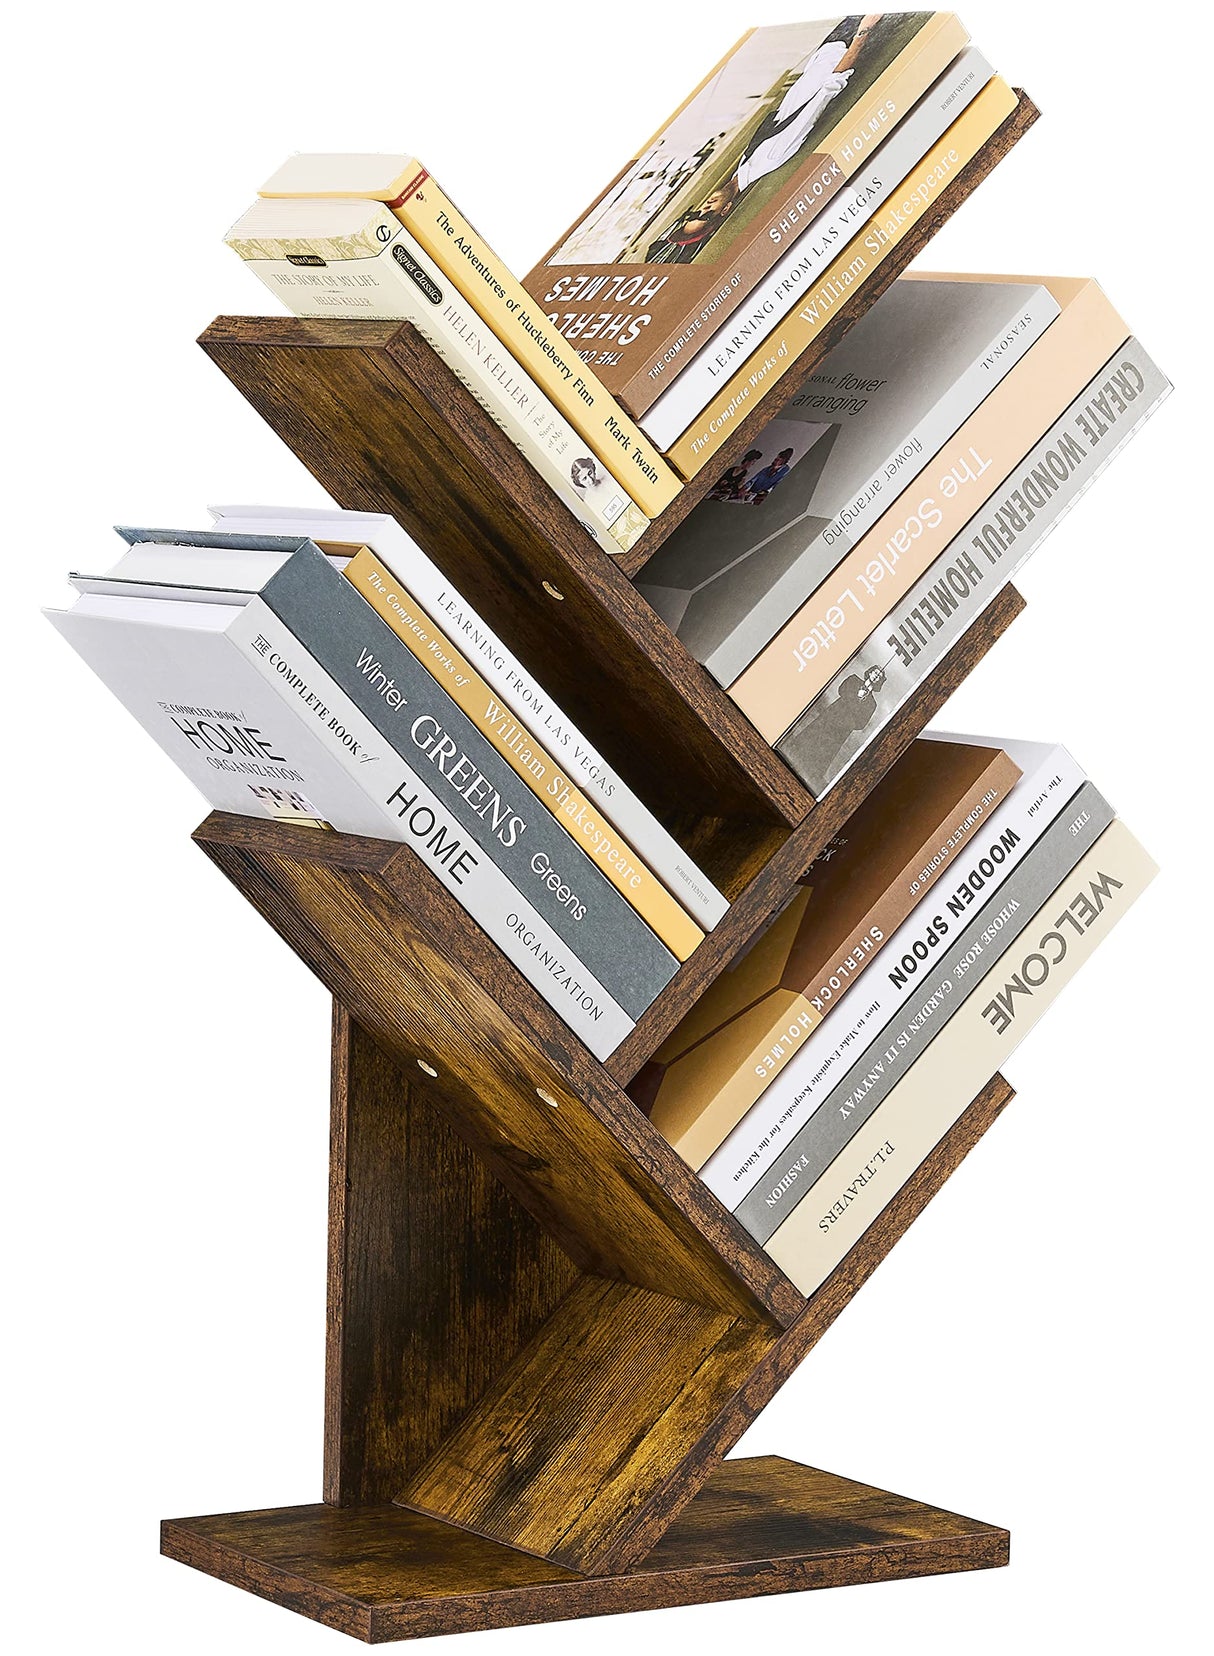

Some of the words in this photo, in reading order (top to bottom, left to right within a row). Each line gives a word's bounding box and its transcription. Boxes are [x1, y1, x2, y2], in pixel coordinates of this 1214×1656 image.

[648, 360, 666, 380] THE
[663, 317, 702, 363] COMPLETE
[700, 286, 732, 323] STORIES
[730, 272, 743, 293] OF
[769, 162, 842, 244] SHERLOCK
[841, 99, 896, 162] HOLMES
[272, 274, 293, 285] THE
[322, 275, 336, 287] OF
[356, 275, 380, 287] LIFE
[393, 247, 417, 273] Signet
[414, 269, 442, 304] Classics
[544, 276, 669, 306] HOLMES
[707, 300, 775, 377] LEARNING
[774, 256, 812, 301] FROM
[811, 226, 839, 258] LAS
[839, 176, 884, 225] VEGAS
[690, 433, 710, 455] The
[709, 386, 750, 435] Complete
[748, 356, 778, 388] Works
[777, 339, 788, 359] of
[799, 253, 868, 328] William
[864, 147, 960, 257] Shakespeare
[436, 211, 454, 236] The
[454, 236, 506, 299] Adventures
[506, 299, 520, 313] of
[517, 311, 573, 380] Huckleberry
[573, 378, 595, 406] Finn
[604, 416, 631, 450] Mark
[632, 447, 659, 484] Twain
[443, 305, 486, 355] HELEN
[483, 353, 529, 408] KELLER
[595, 351, 624, 366] THE
[980, 313, 1033, 370] SEASONAL
[835, 372, 887, 392] flower
[1075, 361, 1145, 446] CREATE
[533, 413, 545, 426] The
[792, 394, 868, 416] arranging
[539, 421, 555, 439] Story
[556, 441, 569, 455] Life
[887, 437, 923, 482] flower
[939, 446, 993, 498] The
[822, 480, 883, 546] arranging
[971, 431, 1088, 565] WONDERFUL
[856, 498, 943, 597] Scarlet
[792, 588, 865, 673] Letter
[886, 550, 984, 667] HOMELIFE
[169, 704, 215, 718] COMPLETE
[437, 592, 505, 670] LEARNING
[505, 670, 544, 715] FROM
[544, 714, 571, 746] LAS
[574, 746, 616, 797] VEGAS
[170, 716, 287, 762] HOME
[367, 571, 387, 594] The
[386, 593, 428, 642] Complete
[426, 639, 456, 674] Works
[454, 672, 471, 688] of
[483, 699, 546, 781] William
[546, 776, 642, 888] Shakespeare
[206, 756, 304, 782] ORGANIZATION
[355, 647, 408, 712] Winter
[410, 715, 527, 847] GREENS
[530, 852, 587, 921] Greens
[1048, 775, 1063, 791] The
[981, 788, 998, 807] THE
[1027, 789, 1050, 818] Artful
[254, 636, 271, 655] THE
[269, 653, 330, 720] COMPLETE
[328, 717, 362, 756] BOOK
[386, 781, 479, 885] HOME
[506, 912, 603, 1022] ORGANIZATION
[947, 805, 984, 849] COMPLETE
[1068, 809, 1091, 837] THE
[918, 847, 949, 883] STORIES
[946, 827, 1021, 918] WOODEN
[909, 881, 920, 896] OF
[979, 898, 1021, 945] WHOSE
[811, 925, 884, 1011] SHERLOCK
[888, 914, 949, 990] SPOON
[952, 941, 984, 980] ROSE
[980, 871, 1124, 1035] WELCOME
[856, 1018, 865, 1029] to
[864, 1000, 881, 1018] How
[910, 979, 953, 1032] GARDEN
[755, 1011, 813, 1078] HOLMES
[839, 1026, 859, 1051] Make
[884, 1045, 901, 1065] IT
[896, 1030, 912, 1049] IS
[811, 1049, 841, 1086] Exquisite
[778, 1085, 813, 1125] Keepsakes
[839, 1060, 886, 1121] ANYWAY
[758, 1137, 771, 1152] the
[769, 1123, 781, 1139] for
[733, 1150, 760, 1182] Kitchen
[765, 1154, 810, 1209] FASHION
